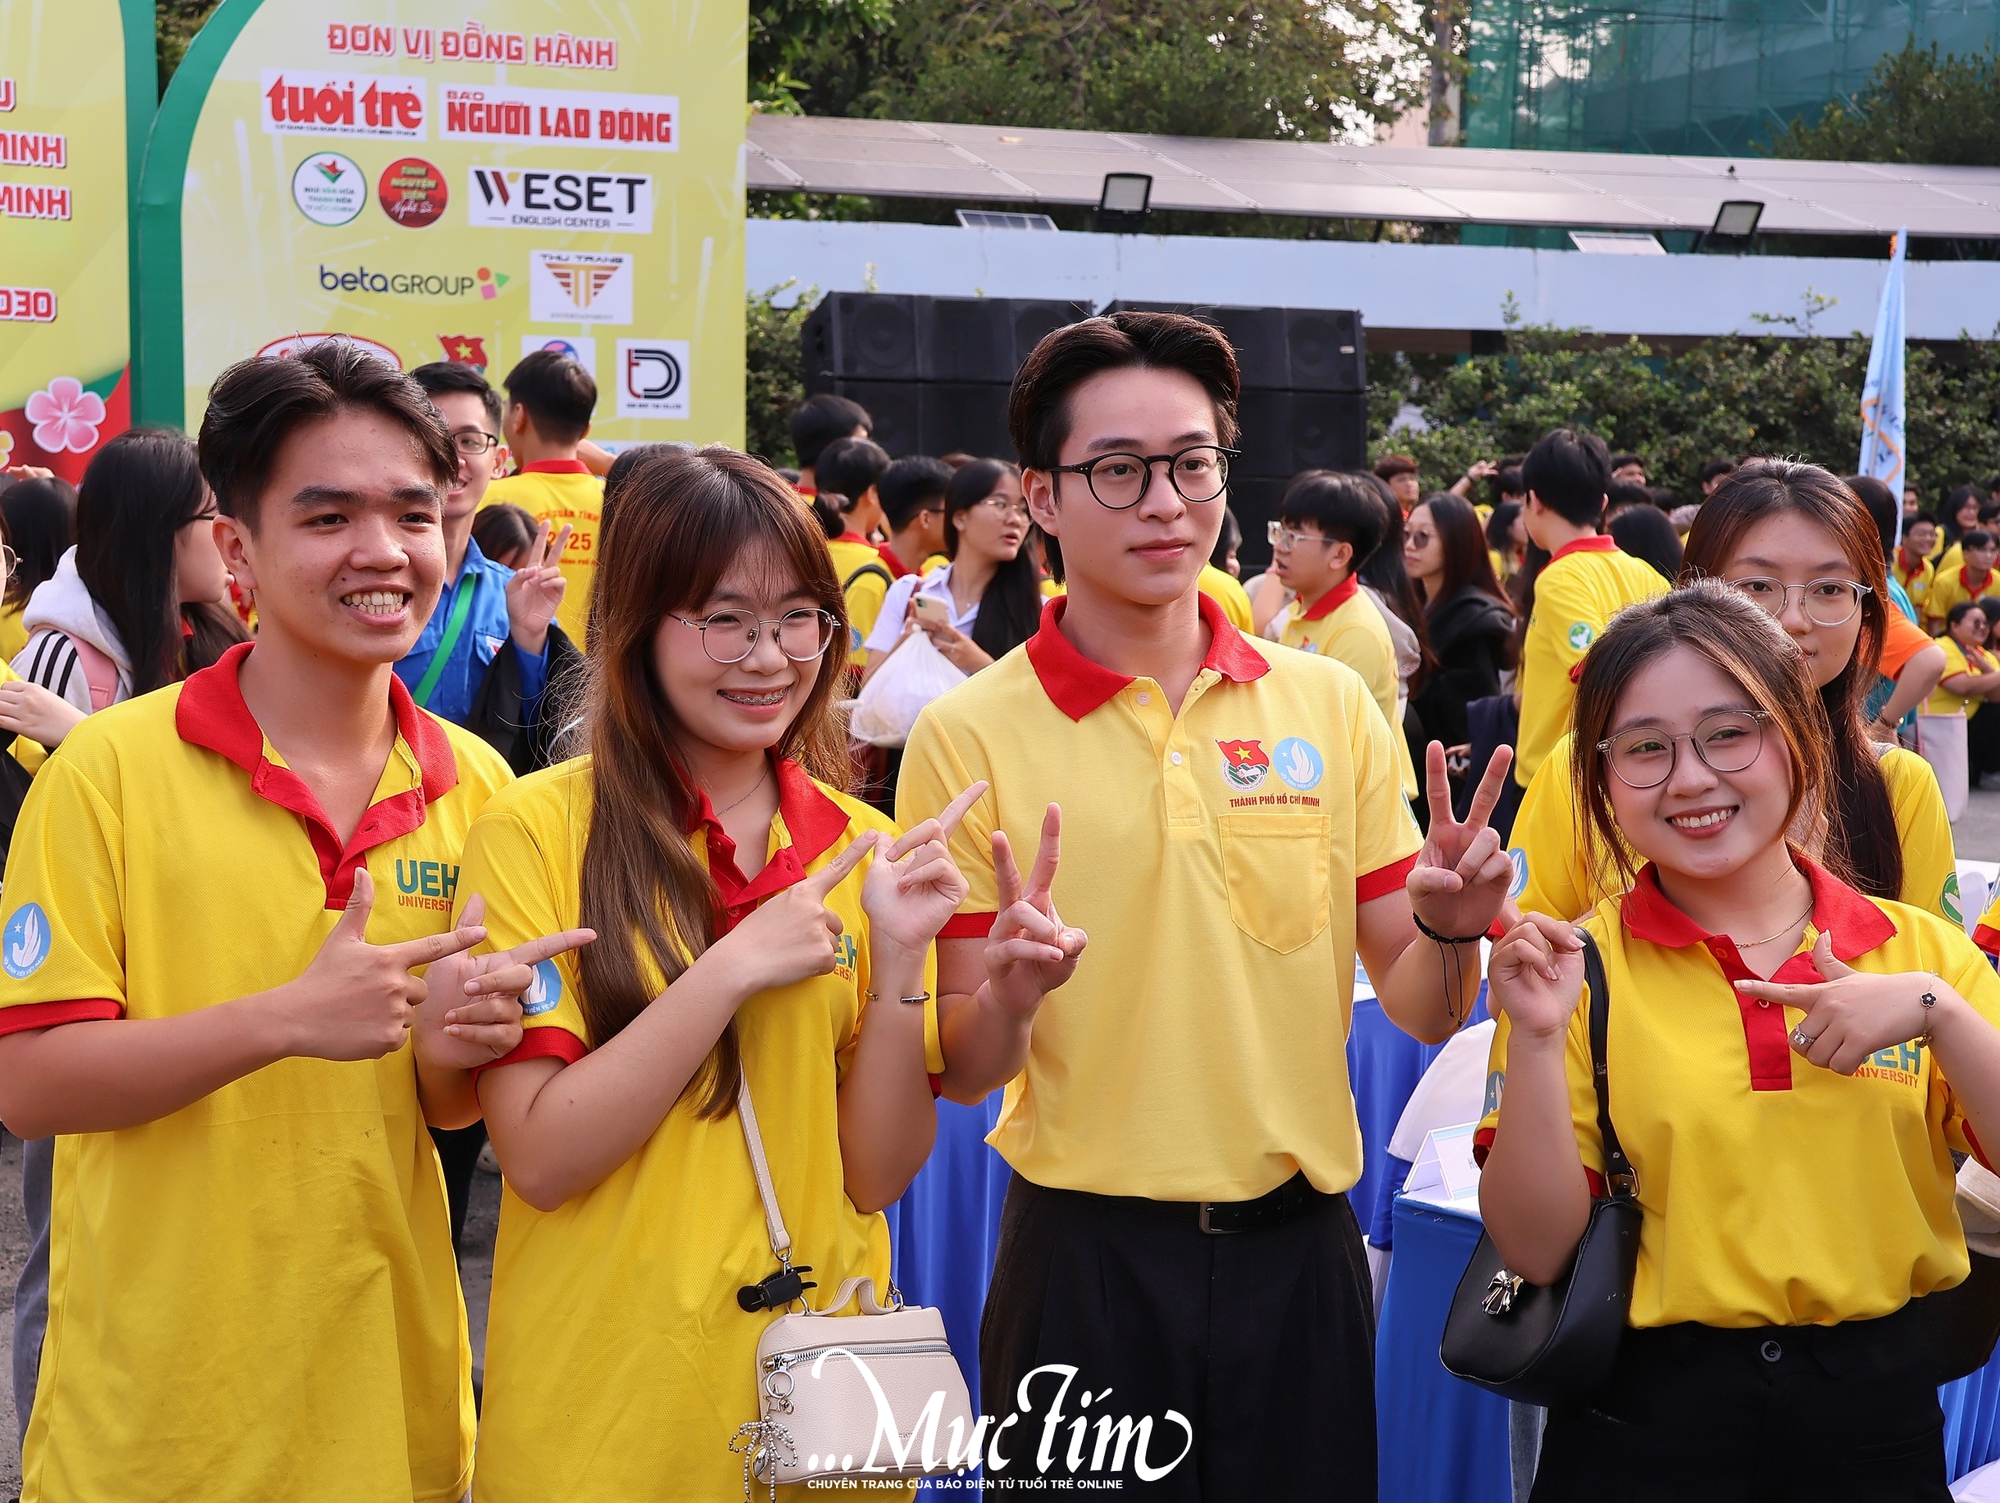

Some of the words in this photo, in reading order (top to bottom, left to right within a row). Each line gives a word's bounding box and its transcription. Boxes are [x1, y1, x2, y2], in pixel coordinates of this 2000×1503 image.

[326, 23, 394, 53] ĐƠN
[402, 27, 433, 61] VỊ
[440, 20, 525, 62] ĐỒNG
[533, 32, 614, 68] HÀNH
[540, 106, 591, 138] LAO
[599, 107, 671, 144] ĐỘNG
[474, 170, 646, 214] WESET
[511, 214, 562, 227] ENGLISH
[564, 216, 611, 229] CENTER
[548, 532, 591, 550] 225
[1229, 795, 1258, 808] THÀNH
[1259, 792, 1276, 805] PHỐ
[1276, 793, 1288, 805] HỒ
[1289, 794, 1301, 805] CHÍ
[1301, 796, 1320, 807] MINH
[396, 858, 460, 899] UEH
[397, 894, 454, 914] UNIVERSIT
[1861, 1040, 1921, 1076] EH
[1853, 1066, 1919, 1089] NIVERSITY
